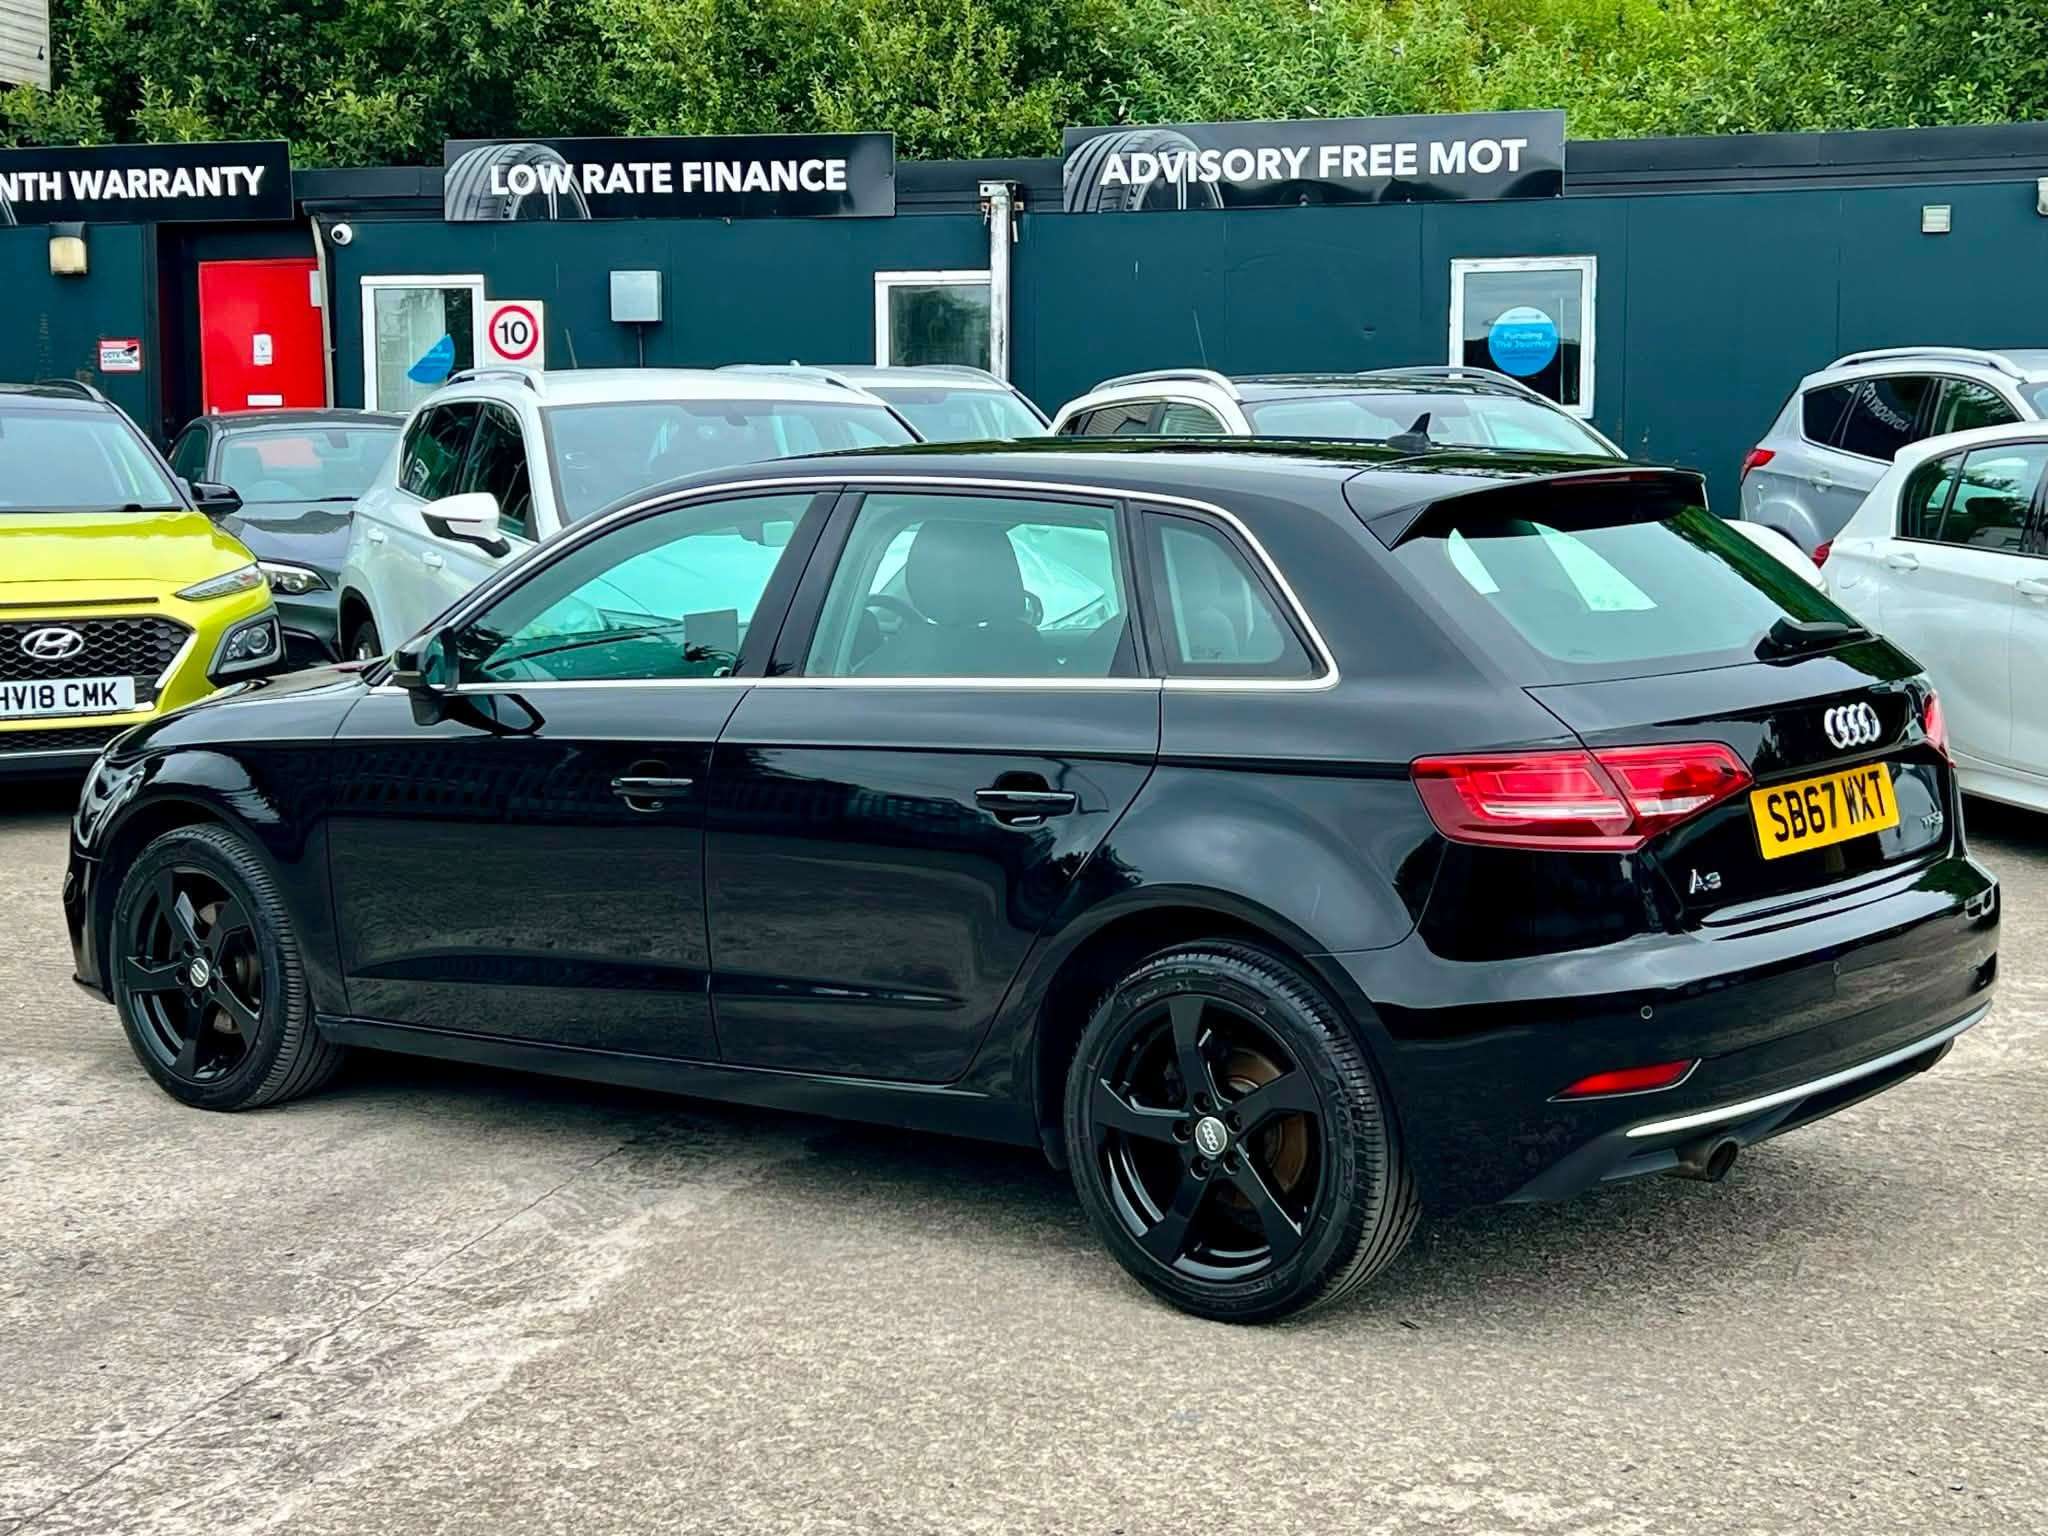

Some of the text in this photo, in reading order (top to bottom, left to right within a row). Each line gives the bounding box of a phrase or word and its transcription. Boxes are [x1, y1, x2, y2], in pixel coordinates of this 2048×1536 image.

[490, 159, 847, 197] LOW RATE FINANCE
[1099, 138, 1528, 186] ADVISORY FREE MOT
[0, 165, 265, 202] NTH WARRANTY
[498, 321, 528, 345] 10
[64, 681, 118, 708] CMK
[1766, 769, 1887, 843] SB67 WXT
[1689, 868, 1722, 894] A3
